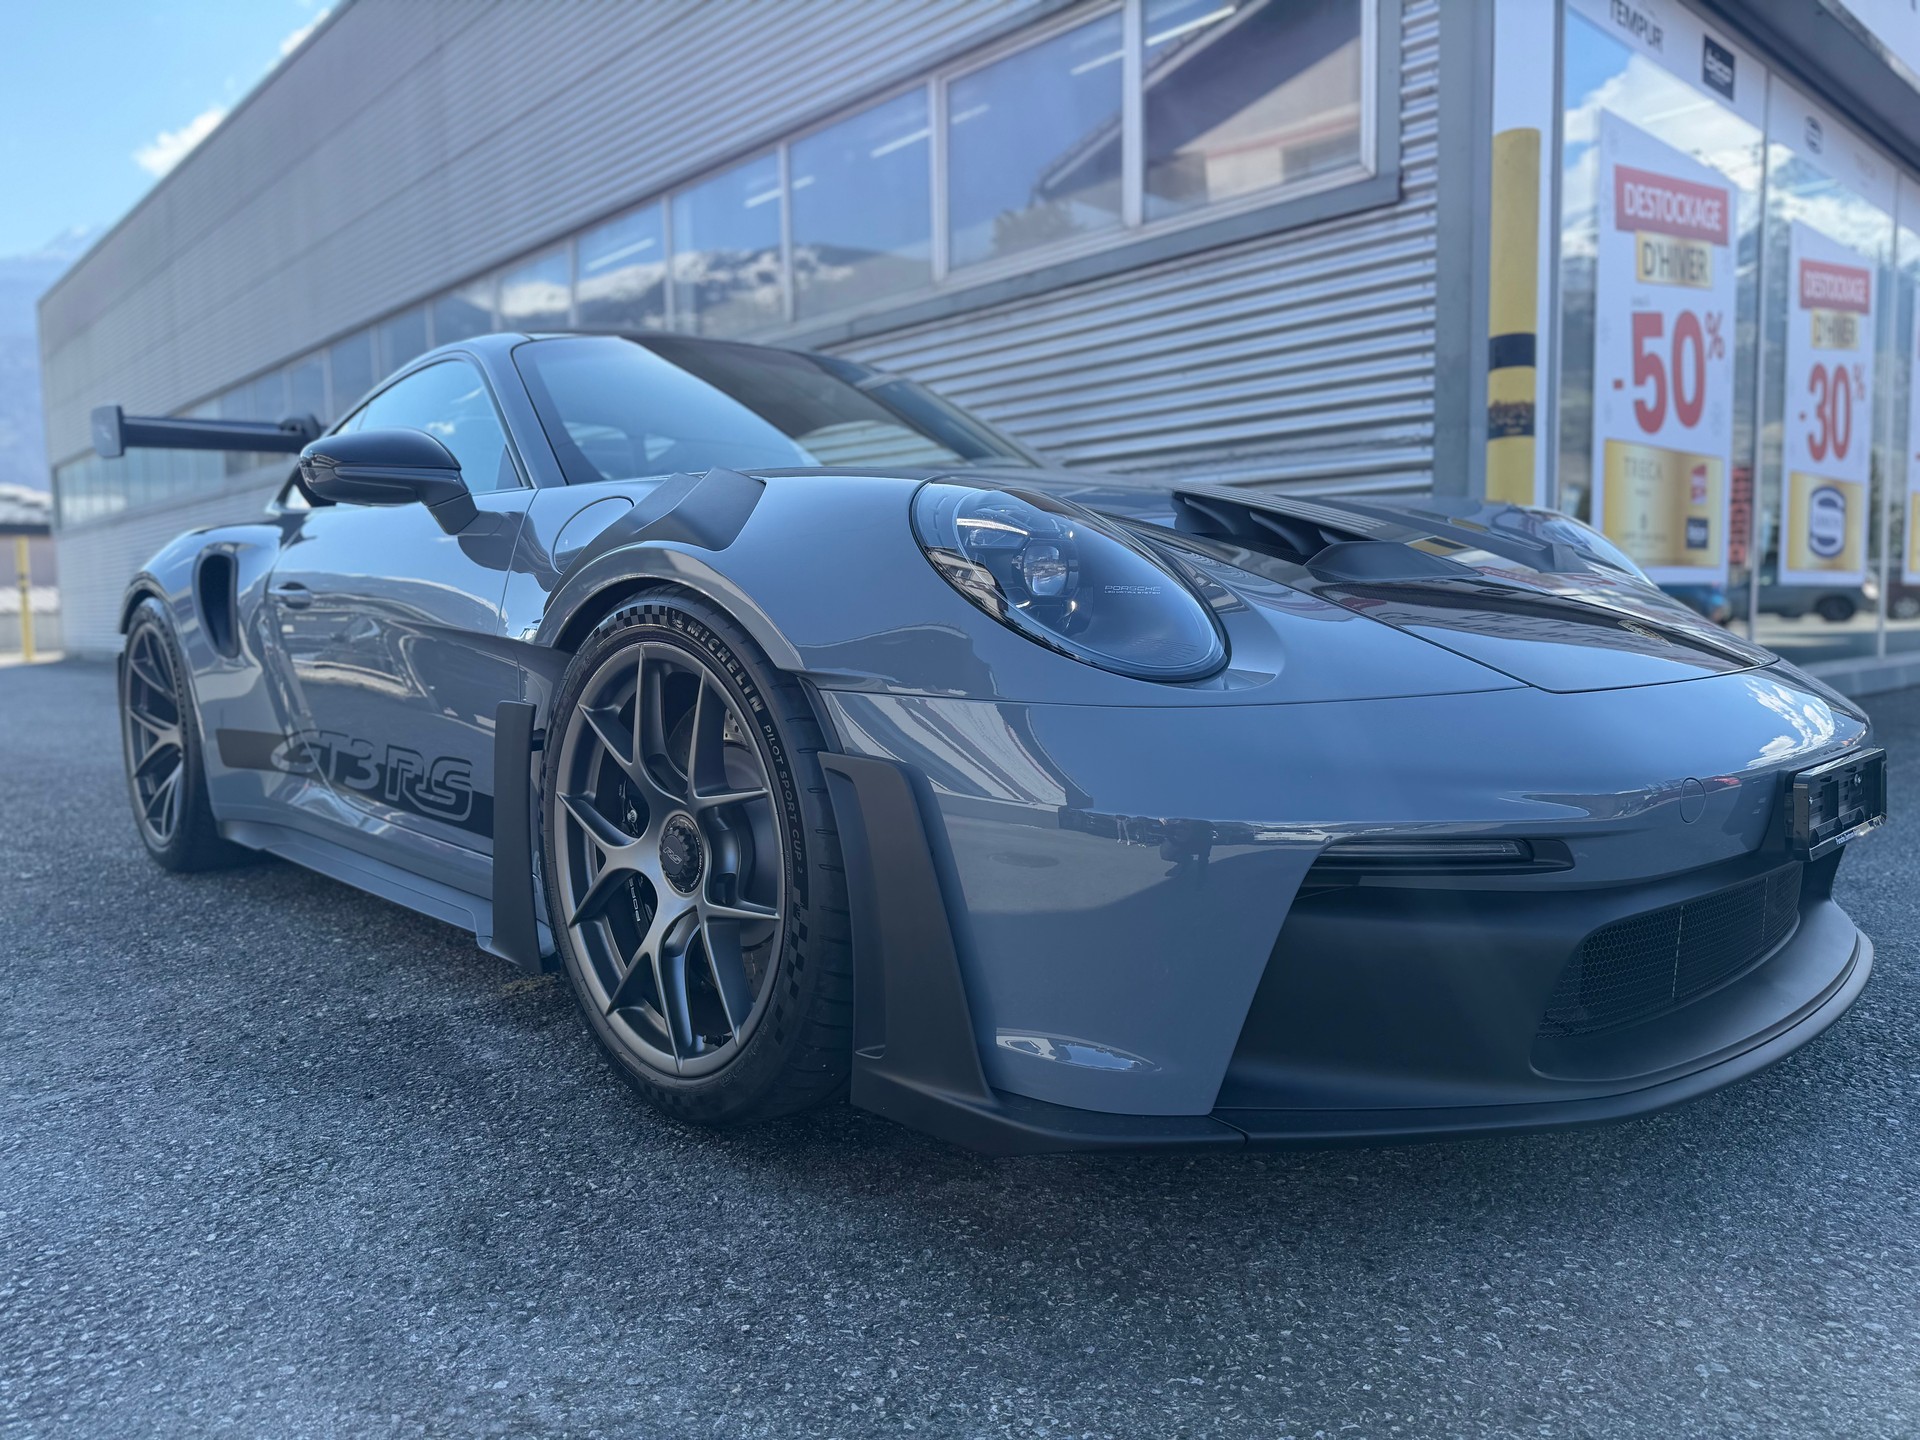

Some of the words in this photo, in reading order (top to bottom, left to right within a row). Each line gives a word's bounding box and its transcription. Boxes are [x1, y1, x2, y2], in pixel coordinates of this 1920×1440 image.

[1610, 0, 1663, 54] TEMPUR
[1623, 181, 1723, 231] DESTOCKAGE
[1643, 241, 1708, 282] D'HIVER
[1803, 269, 1866, 303] DESTOCKAGE
[686, 620, 764, 713] MICHELIN
[763, 724, 784, 765] PILOT
[779, 771, 798, 824] SPORT
[792, 827, 803, 862] CUP
[663, 847, 683, 866] RS
